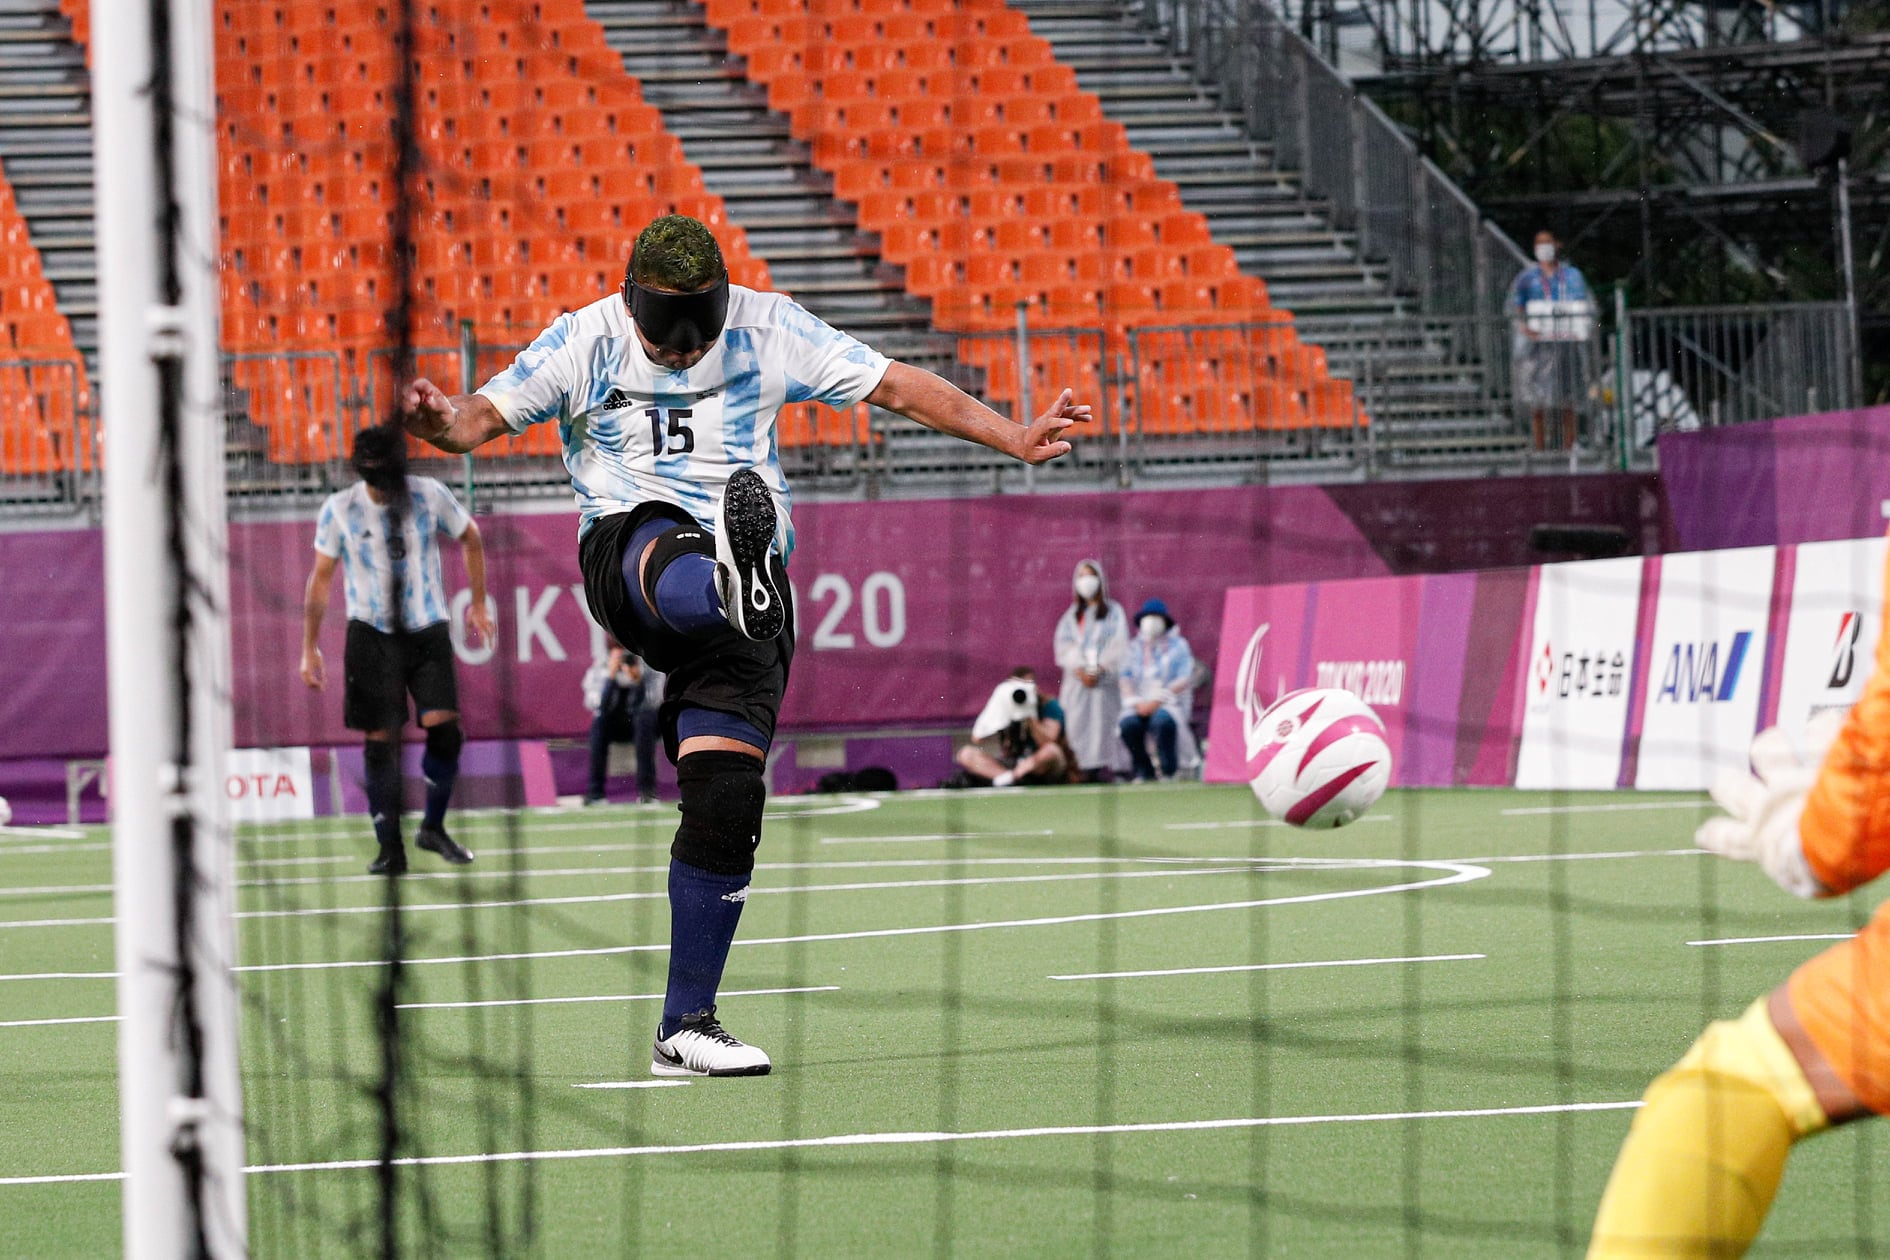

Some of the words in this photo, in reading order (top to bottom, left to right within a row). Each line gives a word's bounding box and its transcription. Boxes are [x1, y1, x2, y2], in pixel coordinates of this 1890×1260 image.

[603, 400, 632, 411] adidas
[645, 408, 694, 457] 15
[449, 584, 609, 667] OKY
[791, 571, 907, 651] 20
[1559, 651, 1624, 698] 日本生命
[1656, 642, 1719, 703] ANA
[225, 774, 297, 800] OTA
